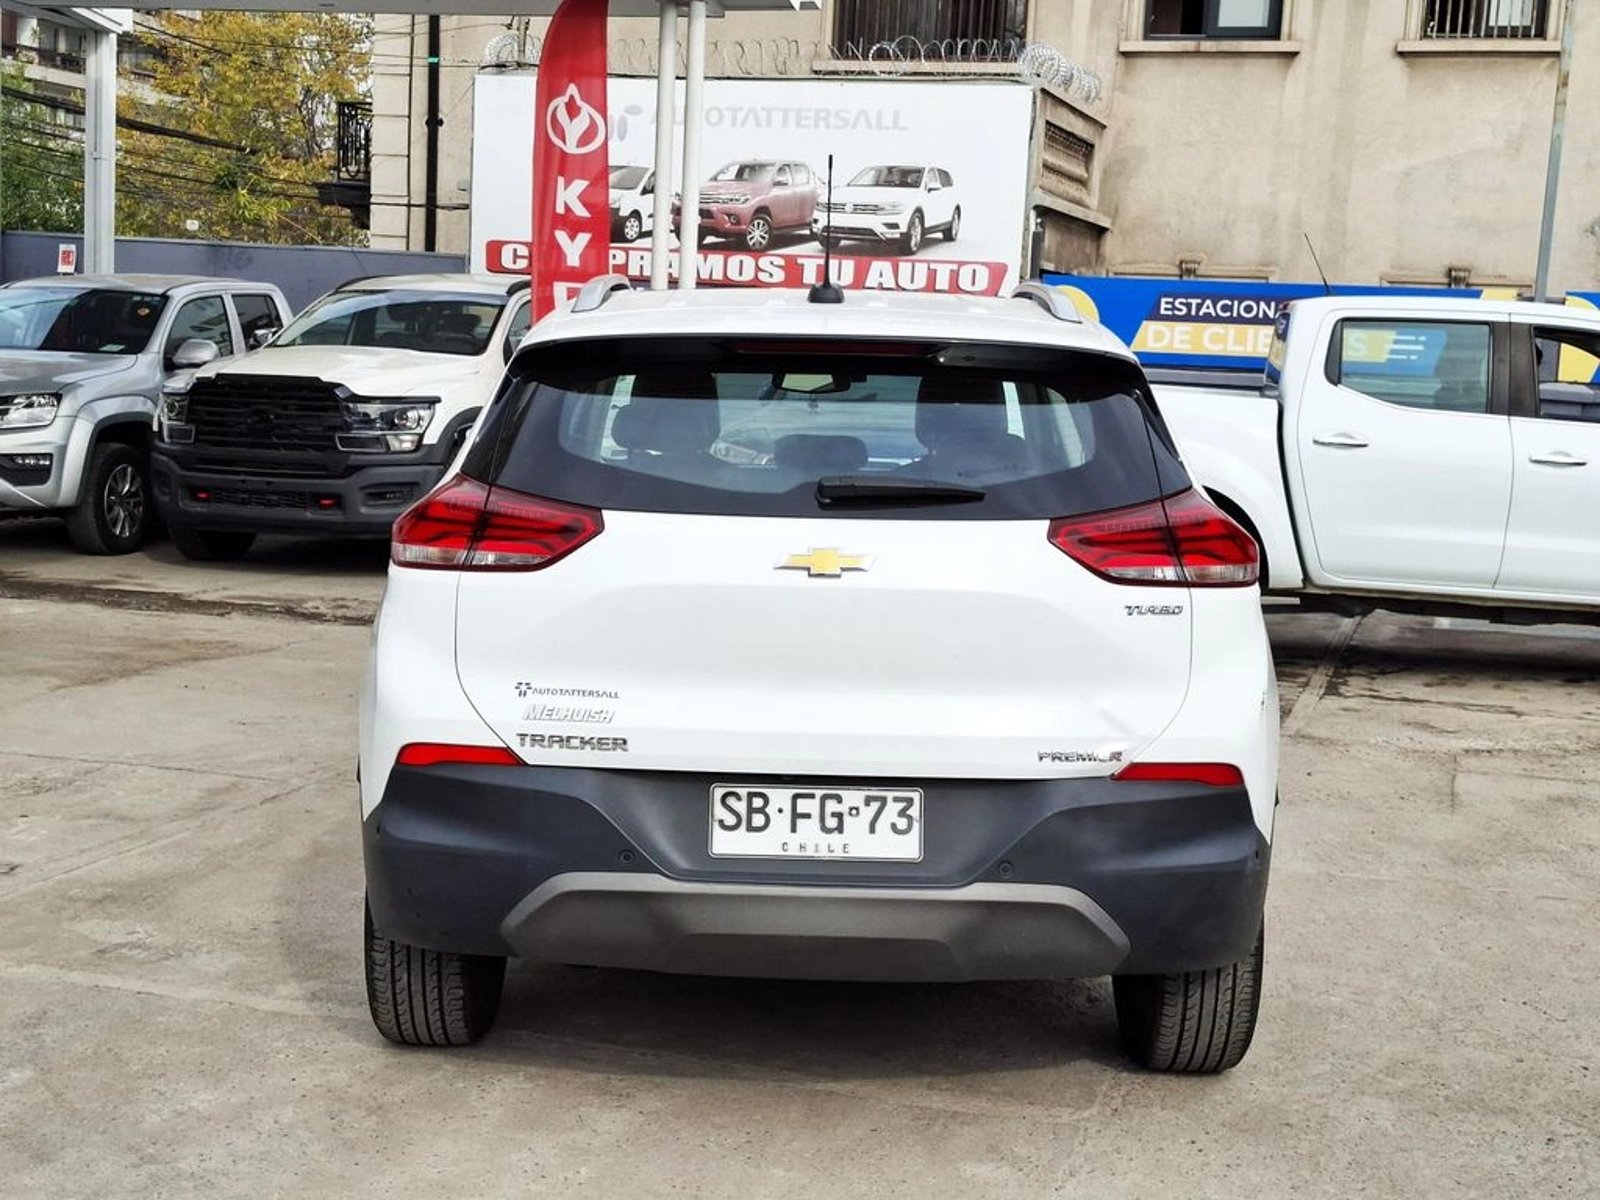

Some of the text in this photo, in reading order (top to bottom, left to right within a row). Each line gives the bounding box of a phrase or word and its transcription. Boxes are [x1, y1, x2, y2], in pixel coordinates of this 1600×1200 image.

[651, 104, 909, 131] OTATTERSALL
[500, 243, 989, 292] CPRAMOS TU AUTO
[1160, 296, 1280, 319] ESTACION
[1146, 324, 1193, 349] DE
[531, 686, 621, 699] AUTOTATTERSALL
[516, 732, 629, 752] TRACKER
[781, 841, 850, 854] CHILE
